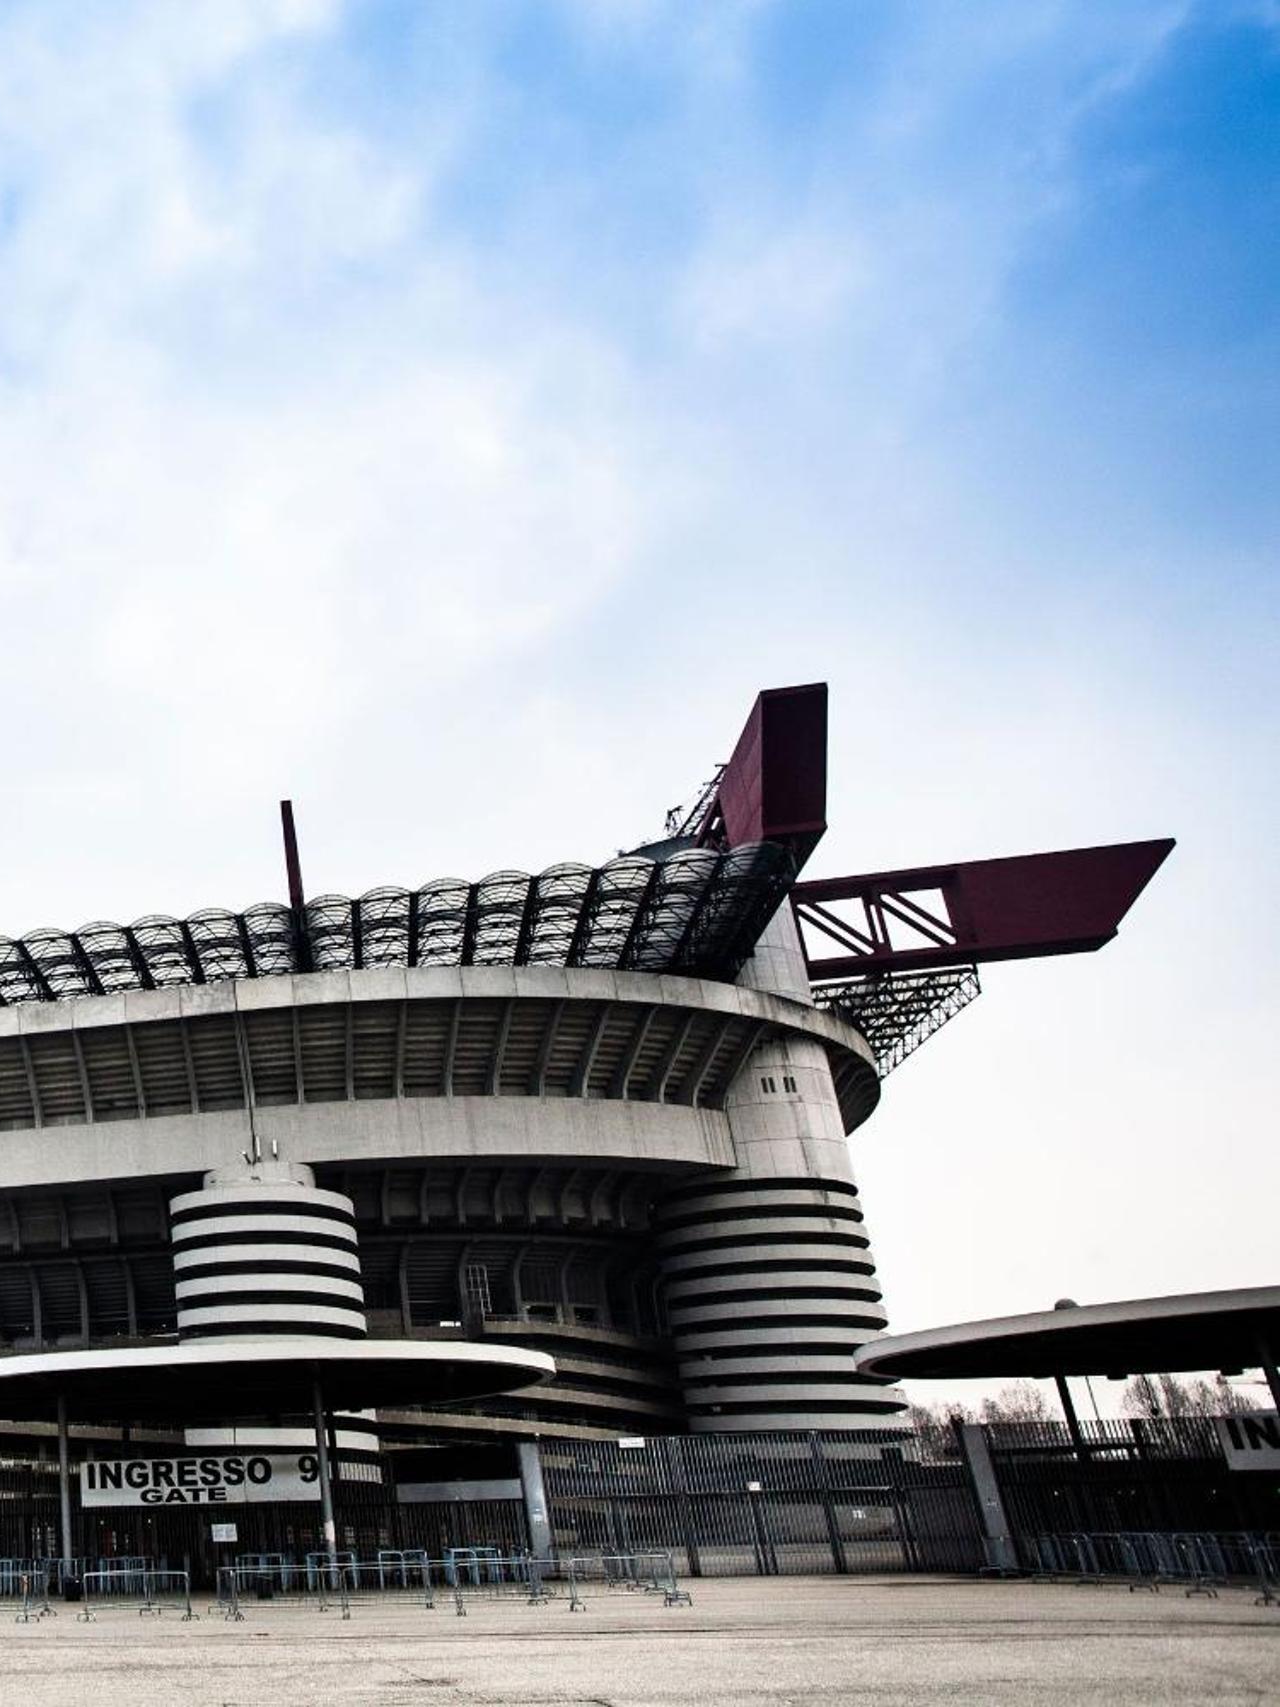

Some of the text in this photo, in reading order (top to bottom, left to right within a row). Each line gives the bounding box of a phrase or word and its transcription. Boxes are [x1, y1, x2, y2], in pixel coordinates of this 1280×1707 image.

[88, 1455, 320, 1490] INGRESSO 9
[140, 1487, 226, 1503] GATE
